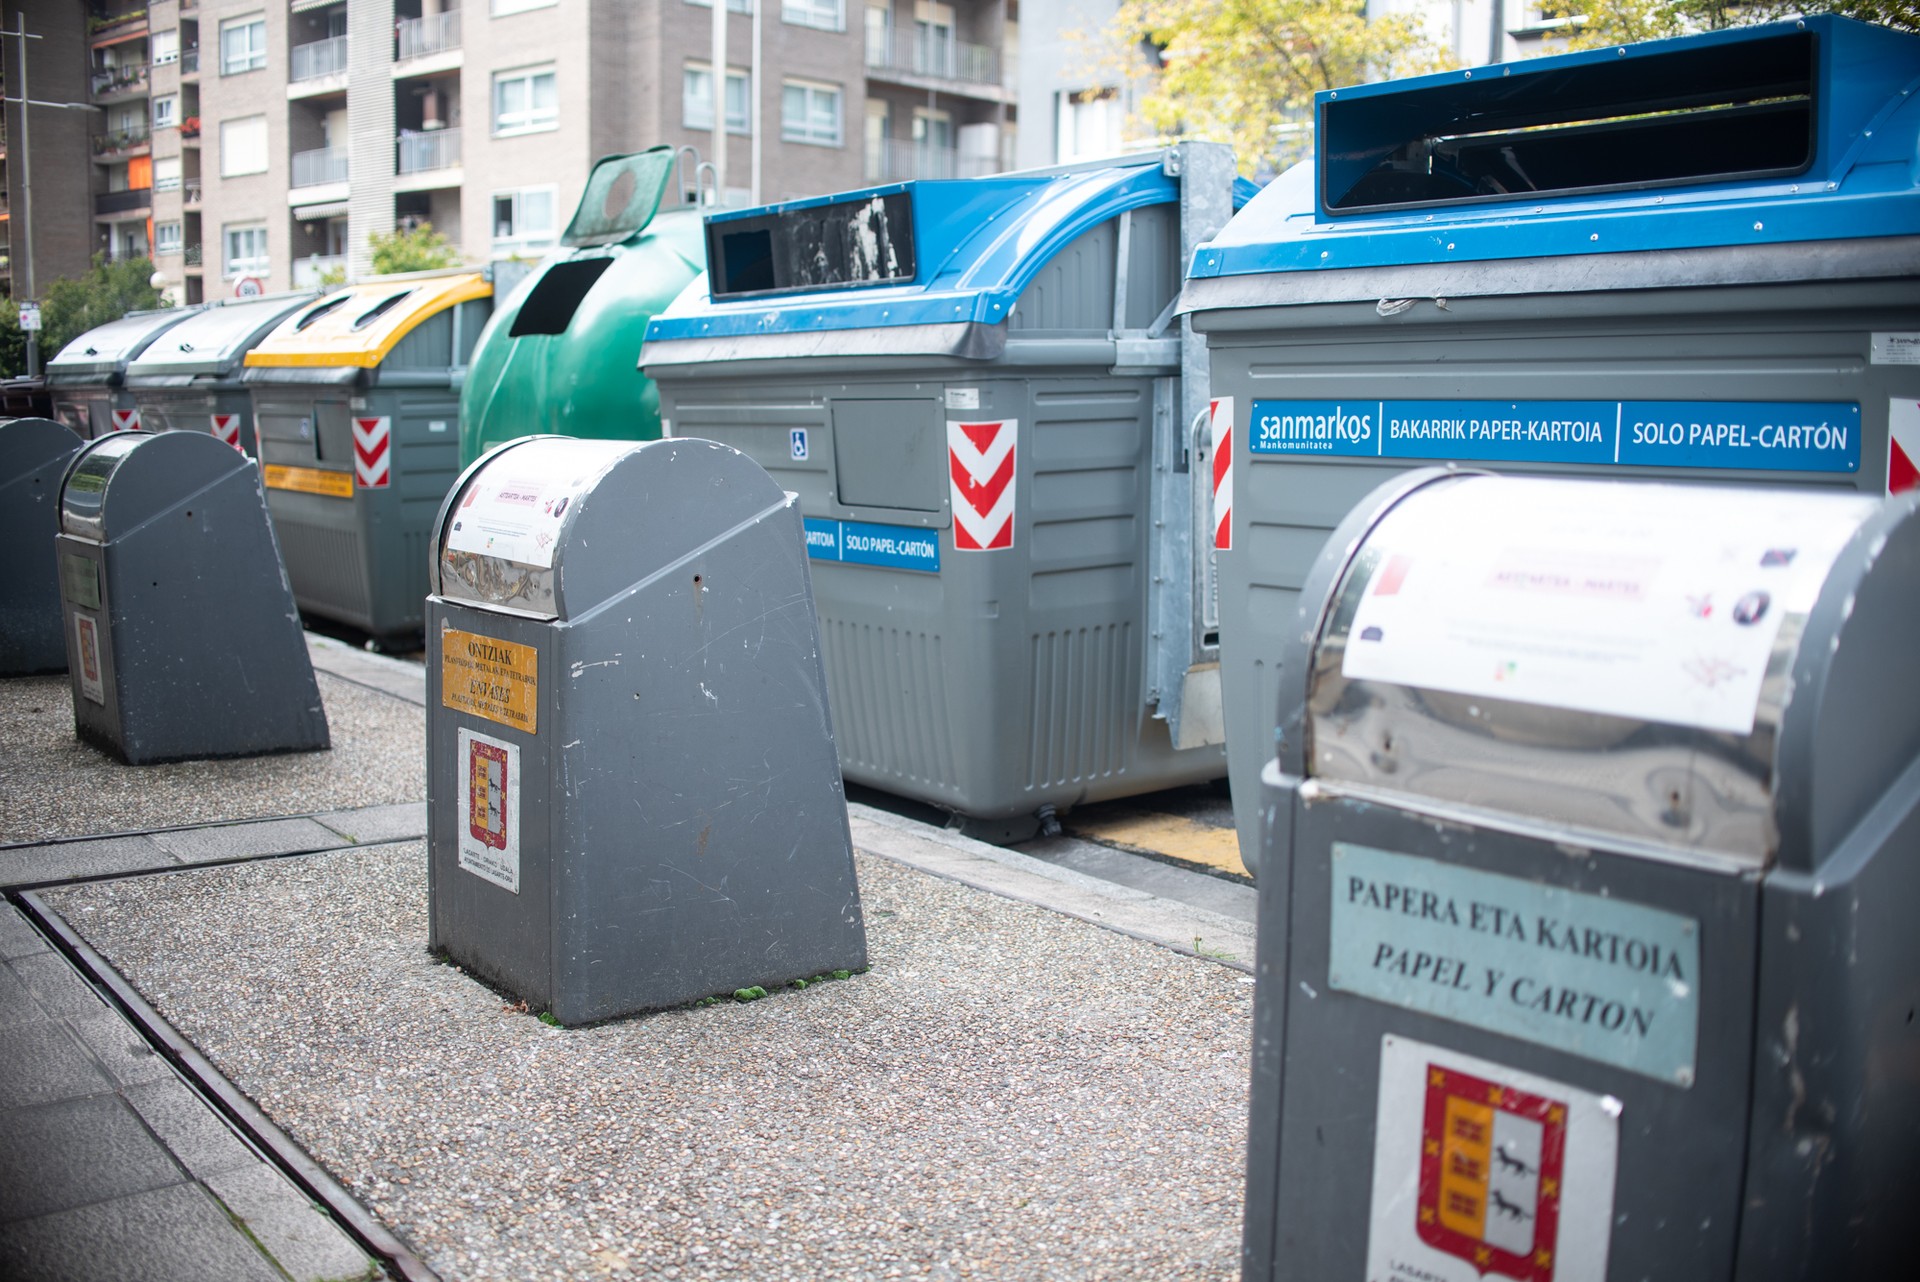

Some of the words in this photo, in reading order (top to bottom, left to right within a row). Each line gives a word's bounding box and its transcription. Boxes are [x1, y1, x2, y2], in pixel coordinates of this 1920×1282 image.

[1259, 405, 1371, 444] sanmarkos
[1390, 419, 1466, 439] BAKARRIK
[1469, 420, 1603, 443] PAPER-KARTOIA
[1632, 422, 1685, 445] SOLO
[1689, 422, 1848, 450] PAPEL-CARTÓN
[1259, 440, 1333, 450] Mankomunitatea
[846, 535, 869, 551] SOLO
[870, 537, 935, 558] PAPEL-CARTÓN
[467, 641, 513, 666] ONTZIAK
[469, 678, 511, 704] ENVASES
[1348, 876, 1459, 926] PAPERA
[1469, 902, 1526, 942] ETA
[1535, 916, 1686, 979] KARTOIA
[1373, 943, 1472, 992] PAPEL
[1484, 969, 1504, 997] Y
[1510, 976, 1655, 1039] CARTON
